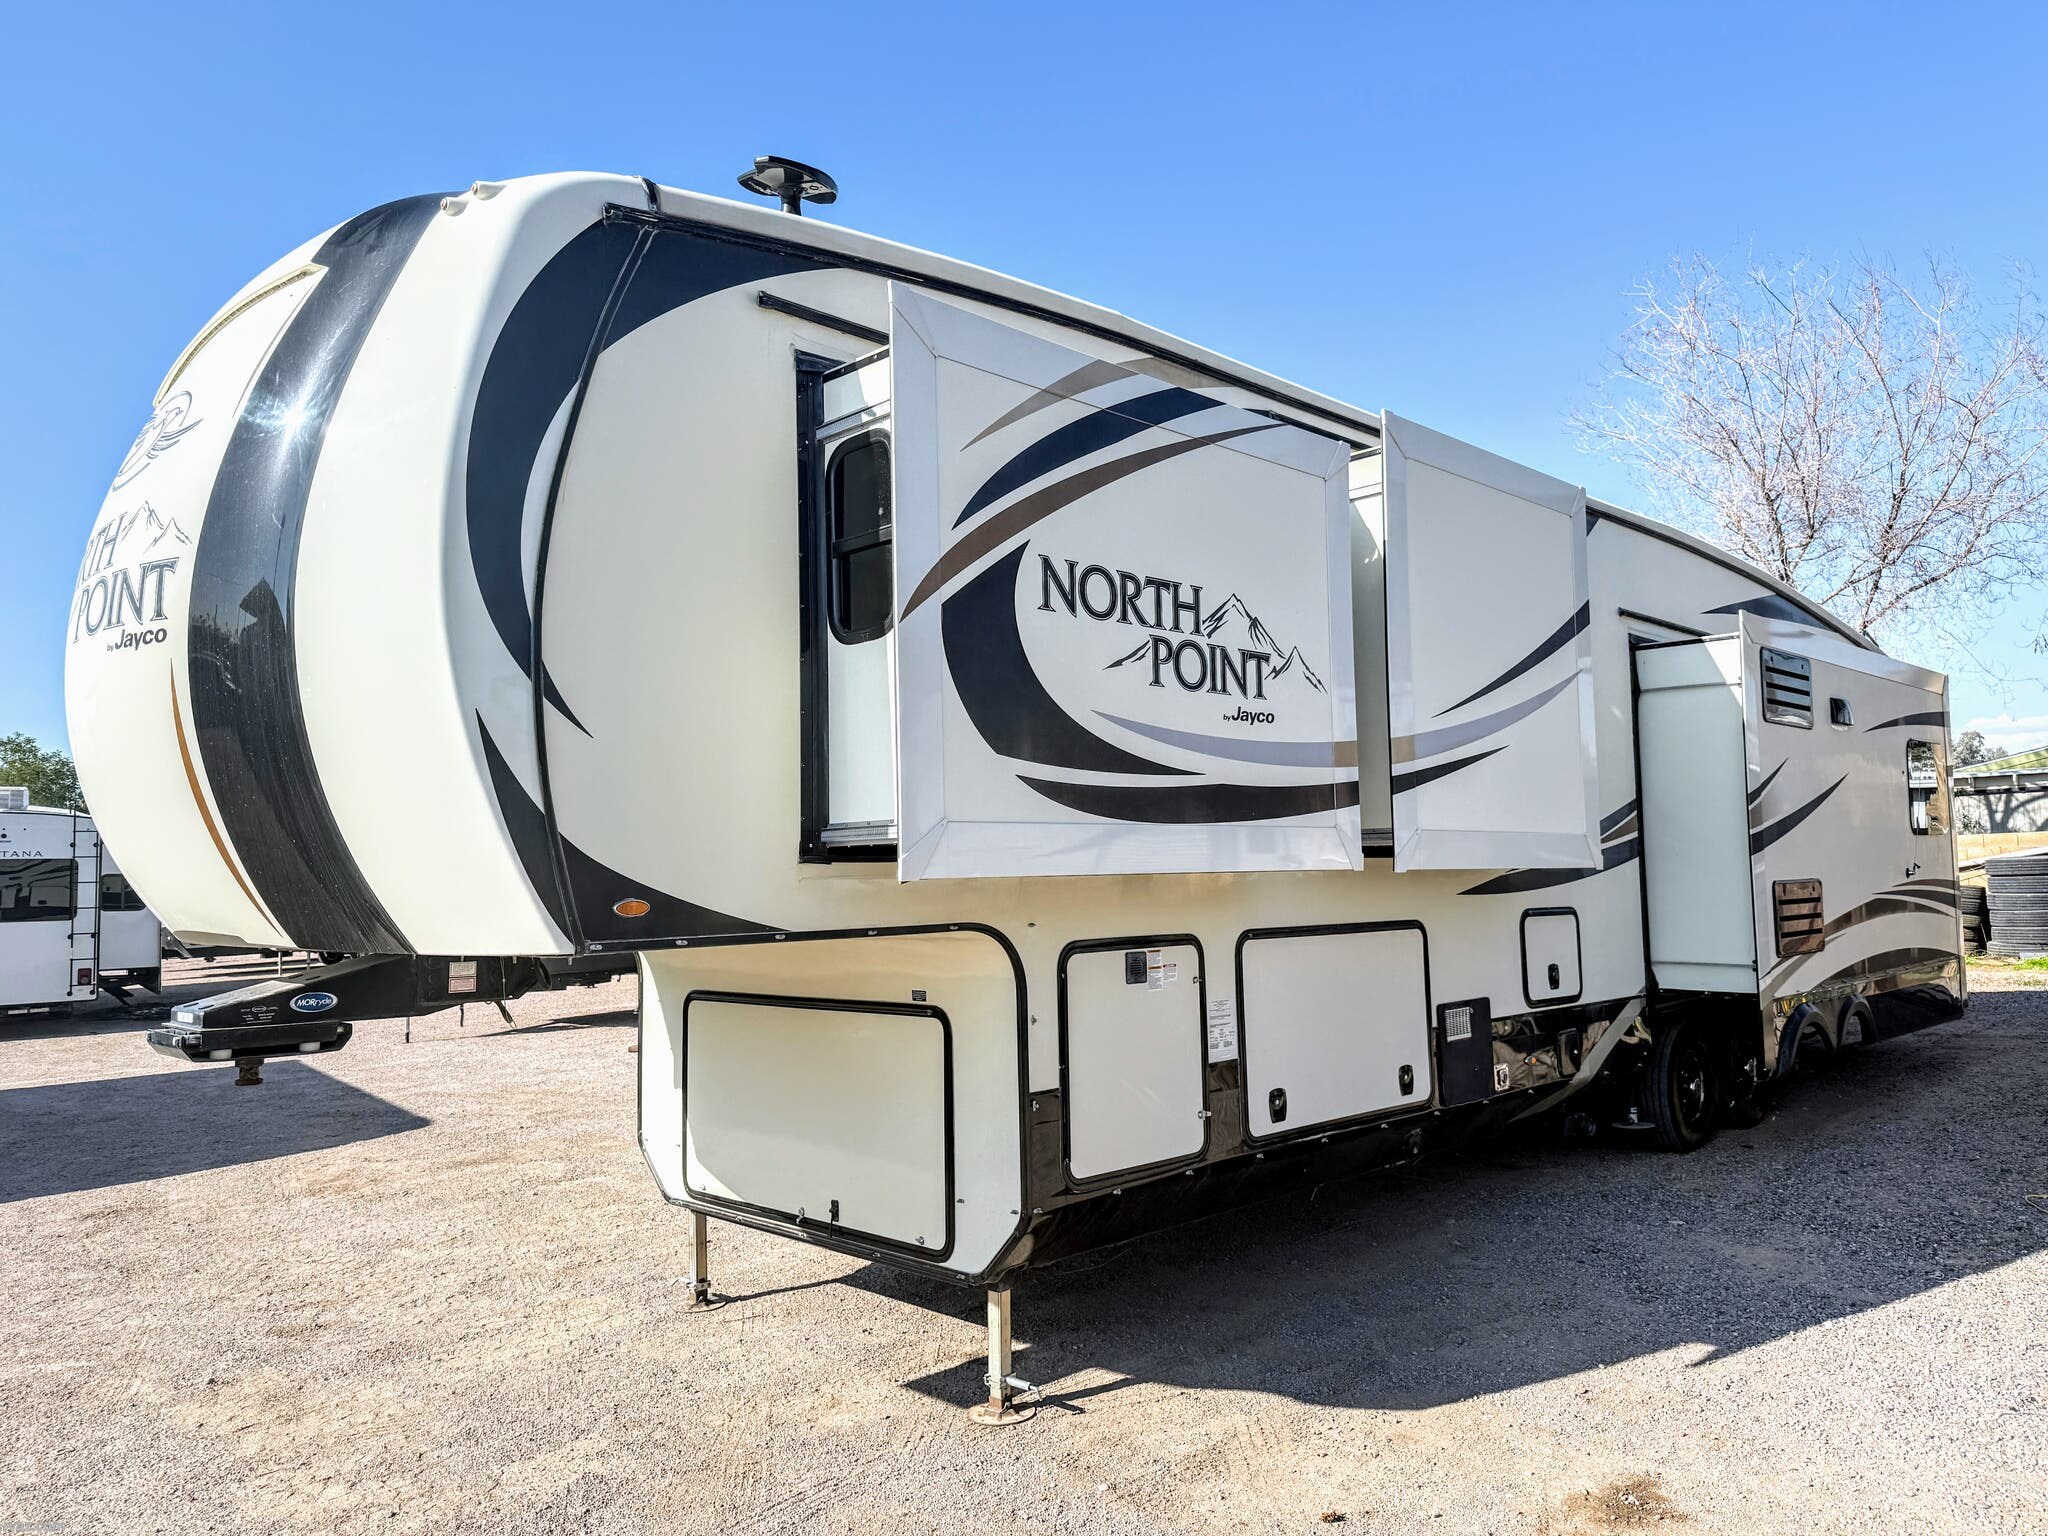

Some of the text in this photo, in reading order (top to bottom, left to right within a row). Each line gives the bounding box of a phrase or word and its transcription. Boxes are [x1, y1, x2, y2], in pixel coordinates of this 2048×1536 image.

[73, 556, 180, 644] POINT
[1037, 553, 1205, 636] NORTH
[114, 627, 168, 652] Jayco
[1148, 634, 1272, 700] POINT
[1222, 706, 1275, 725] by Jayco
[0, 850, 44, 858] TANA
